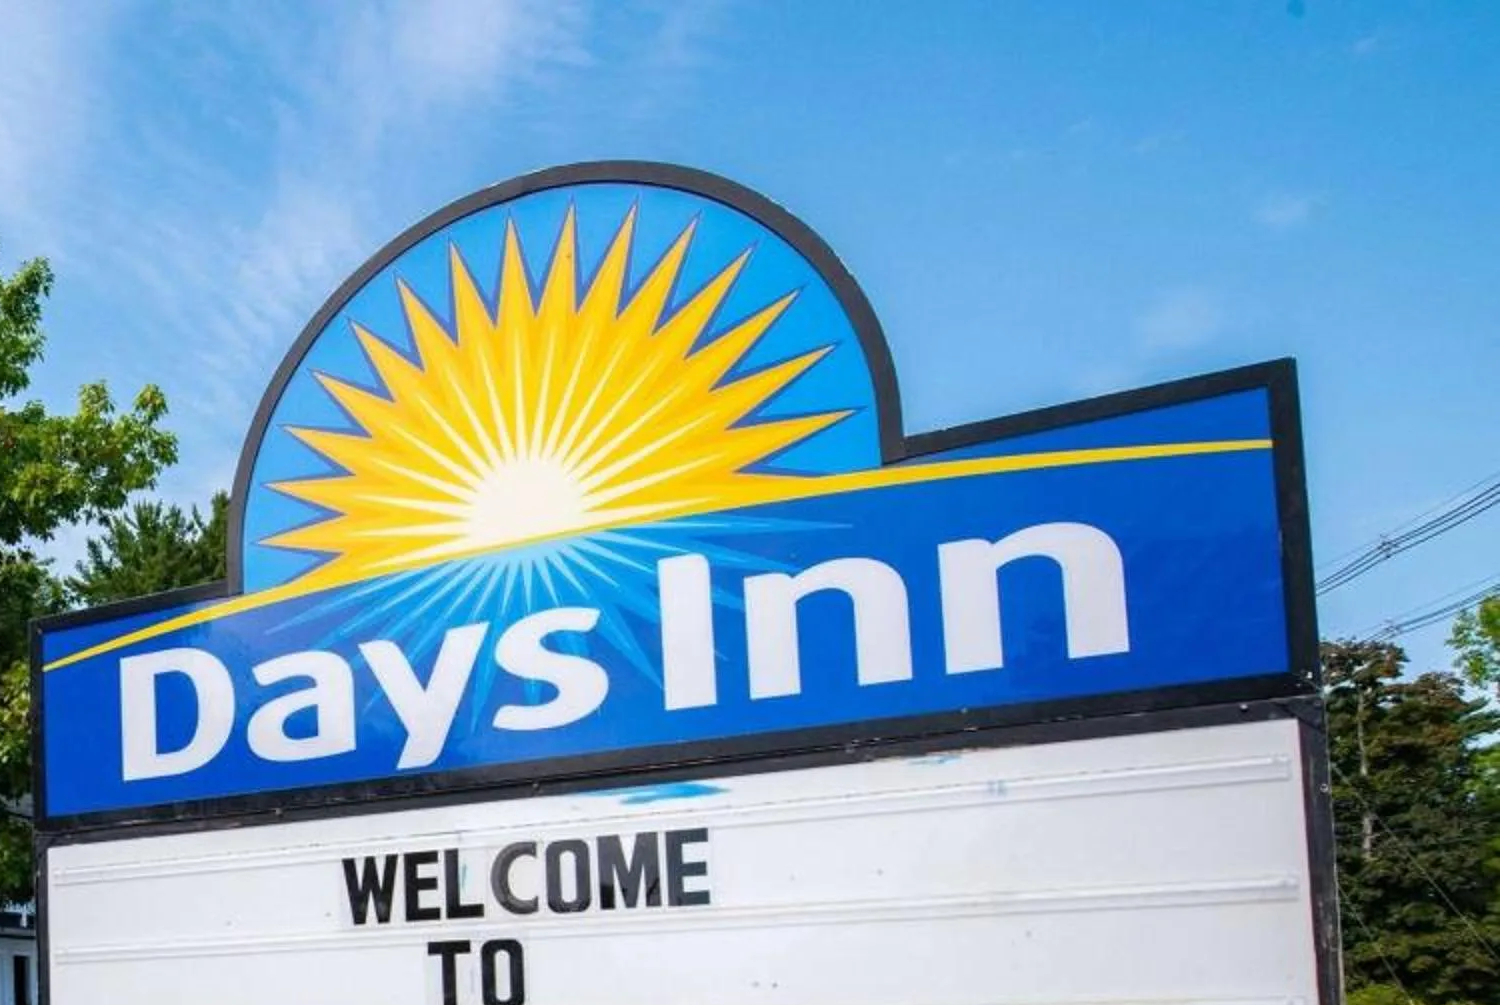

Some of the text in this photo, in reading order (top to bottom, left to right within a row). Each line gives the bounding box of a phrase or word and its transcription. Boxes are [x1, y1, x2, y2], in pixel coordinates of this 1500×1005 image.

[120, 521, 1130, 782] Days Inn
[342, 827, 711, 925] WELCOME
